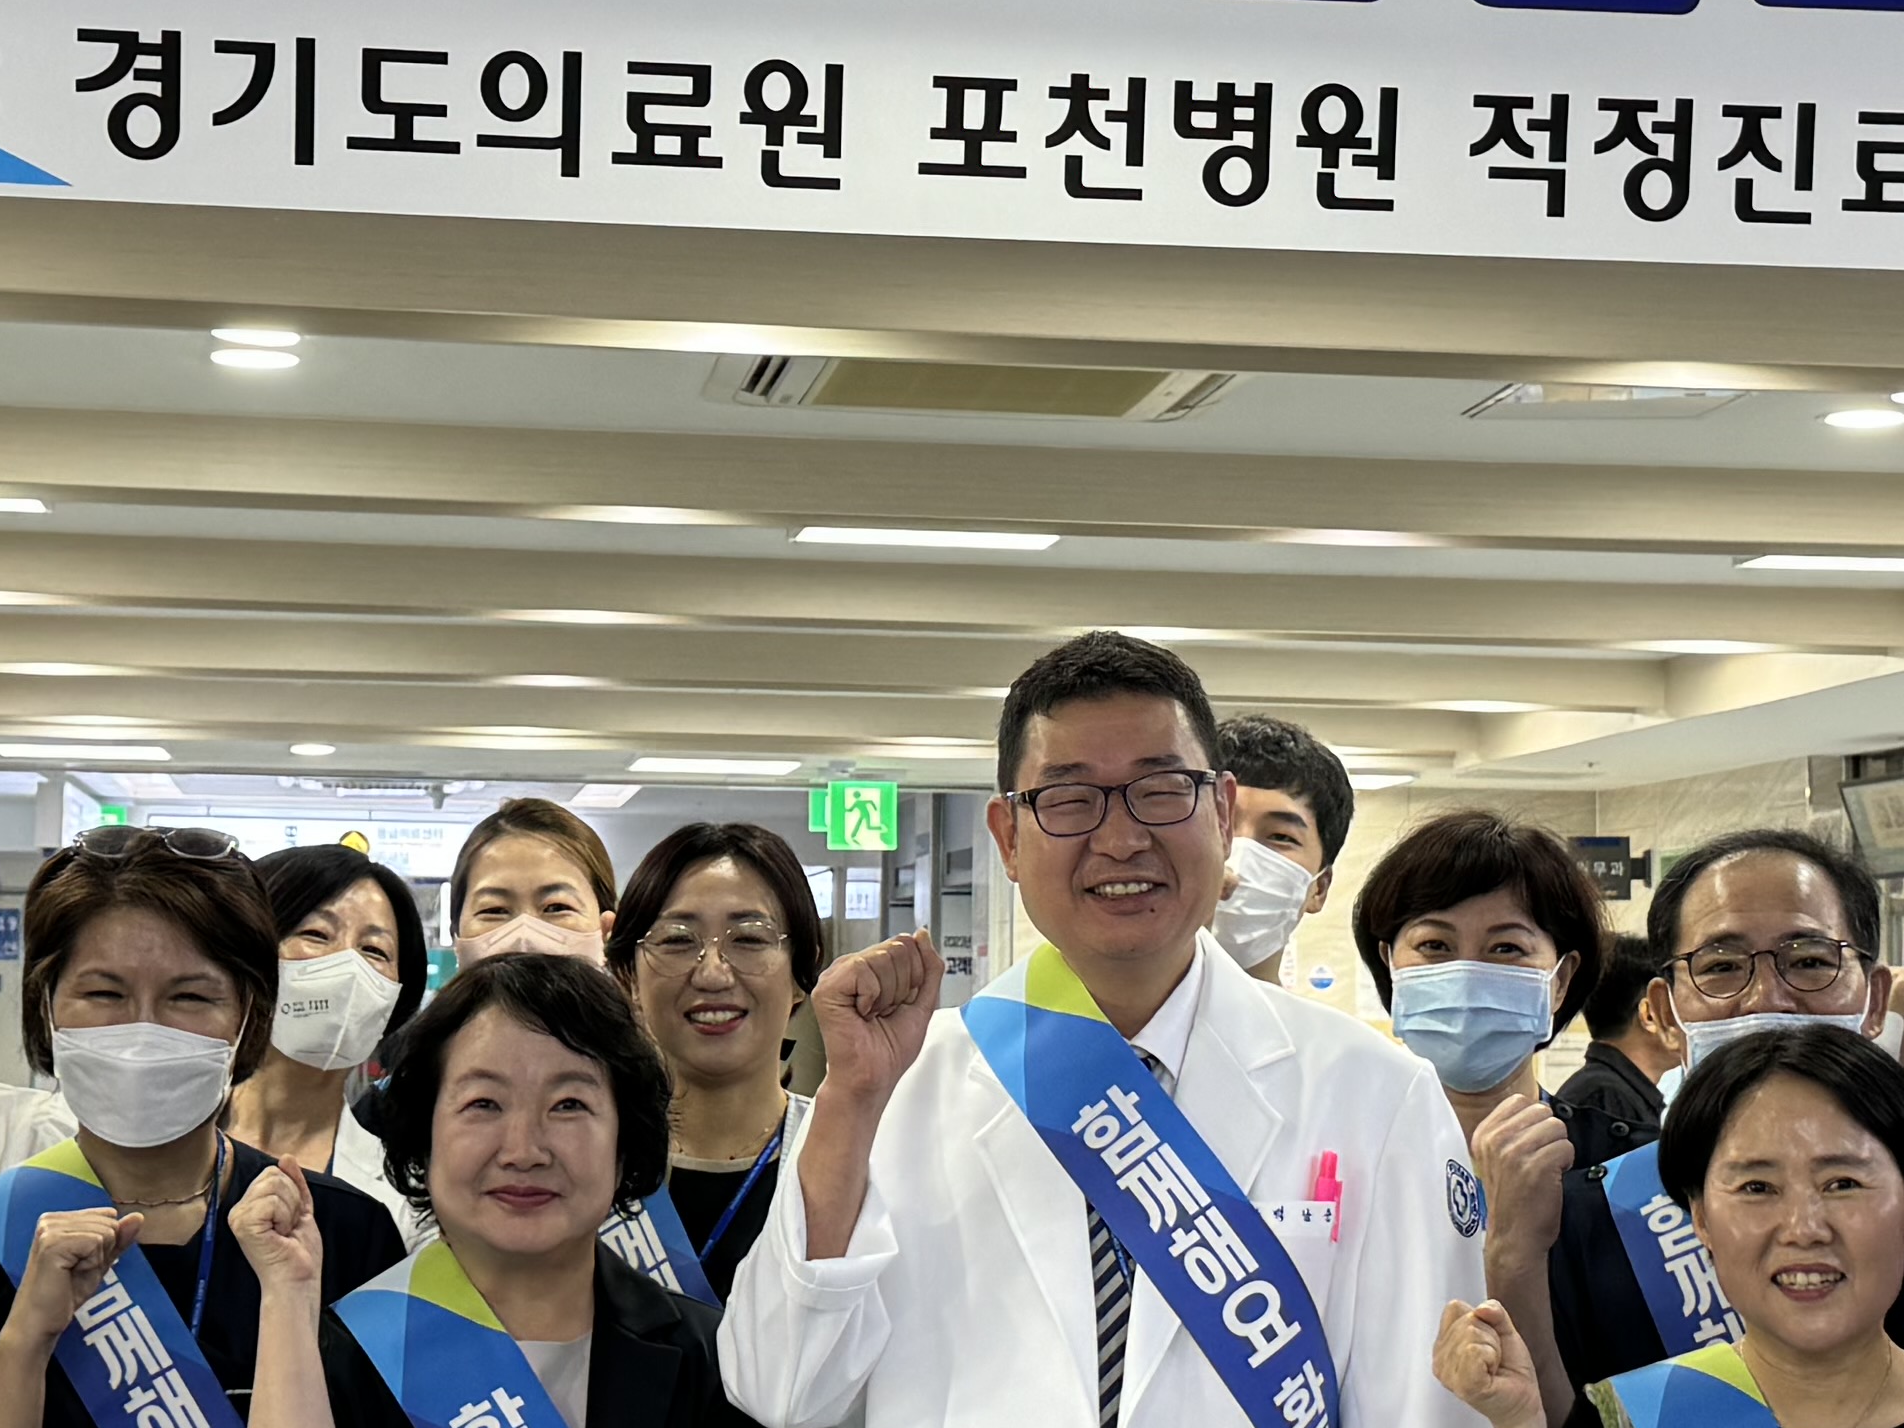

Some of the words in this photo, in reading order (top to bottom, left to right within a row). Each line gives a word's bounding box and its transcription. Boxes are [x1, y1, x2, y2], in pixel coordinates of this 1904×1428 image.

[73, 26, 846, 191] 경기도의료원
[918, 72, 1399, 212] 포천병원
[1072, 1084, 1302, 1368] 함께해요
